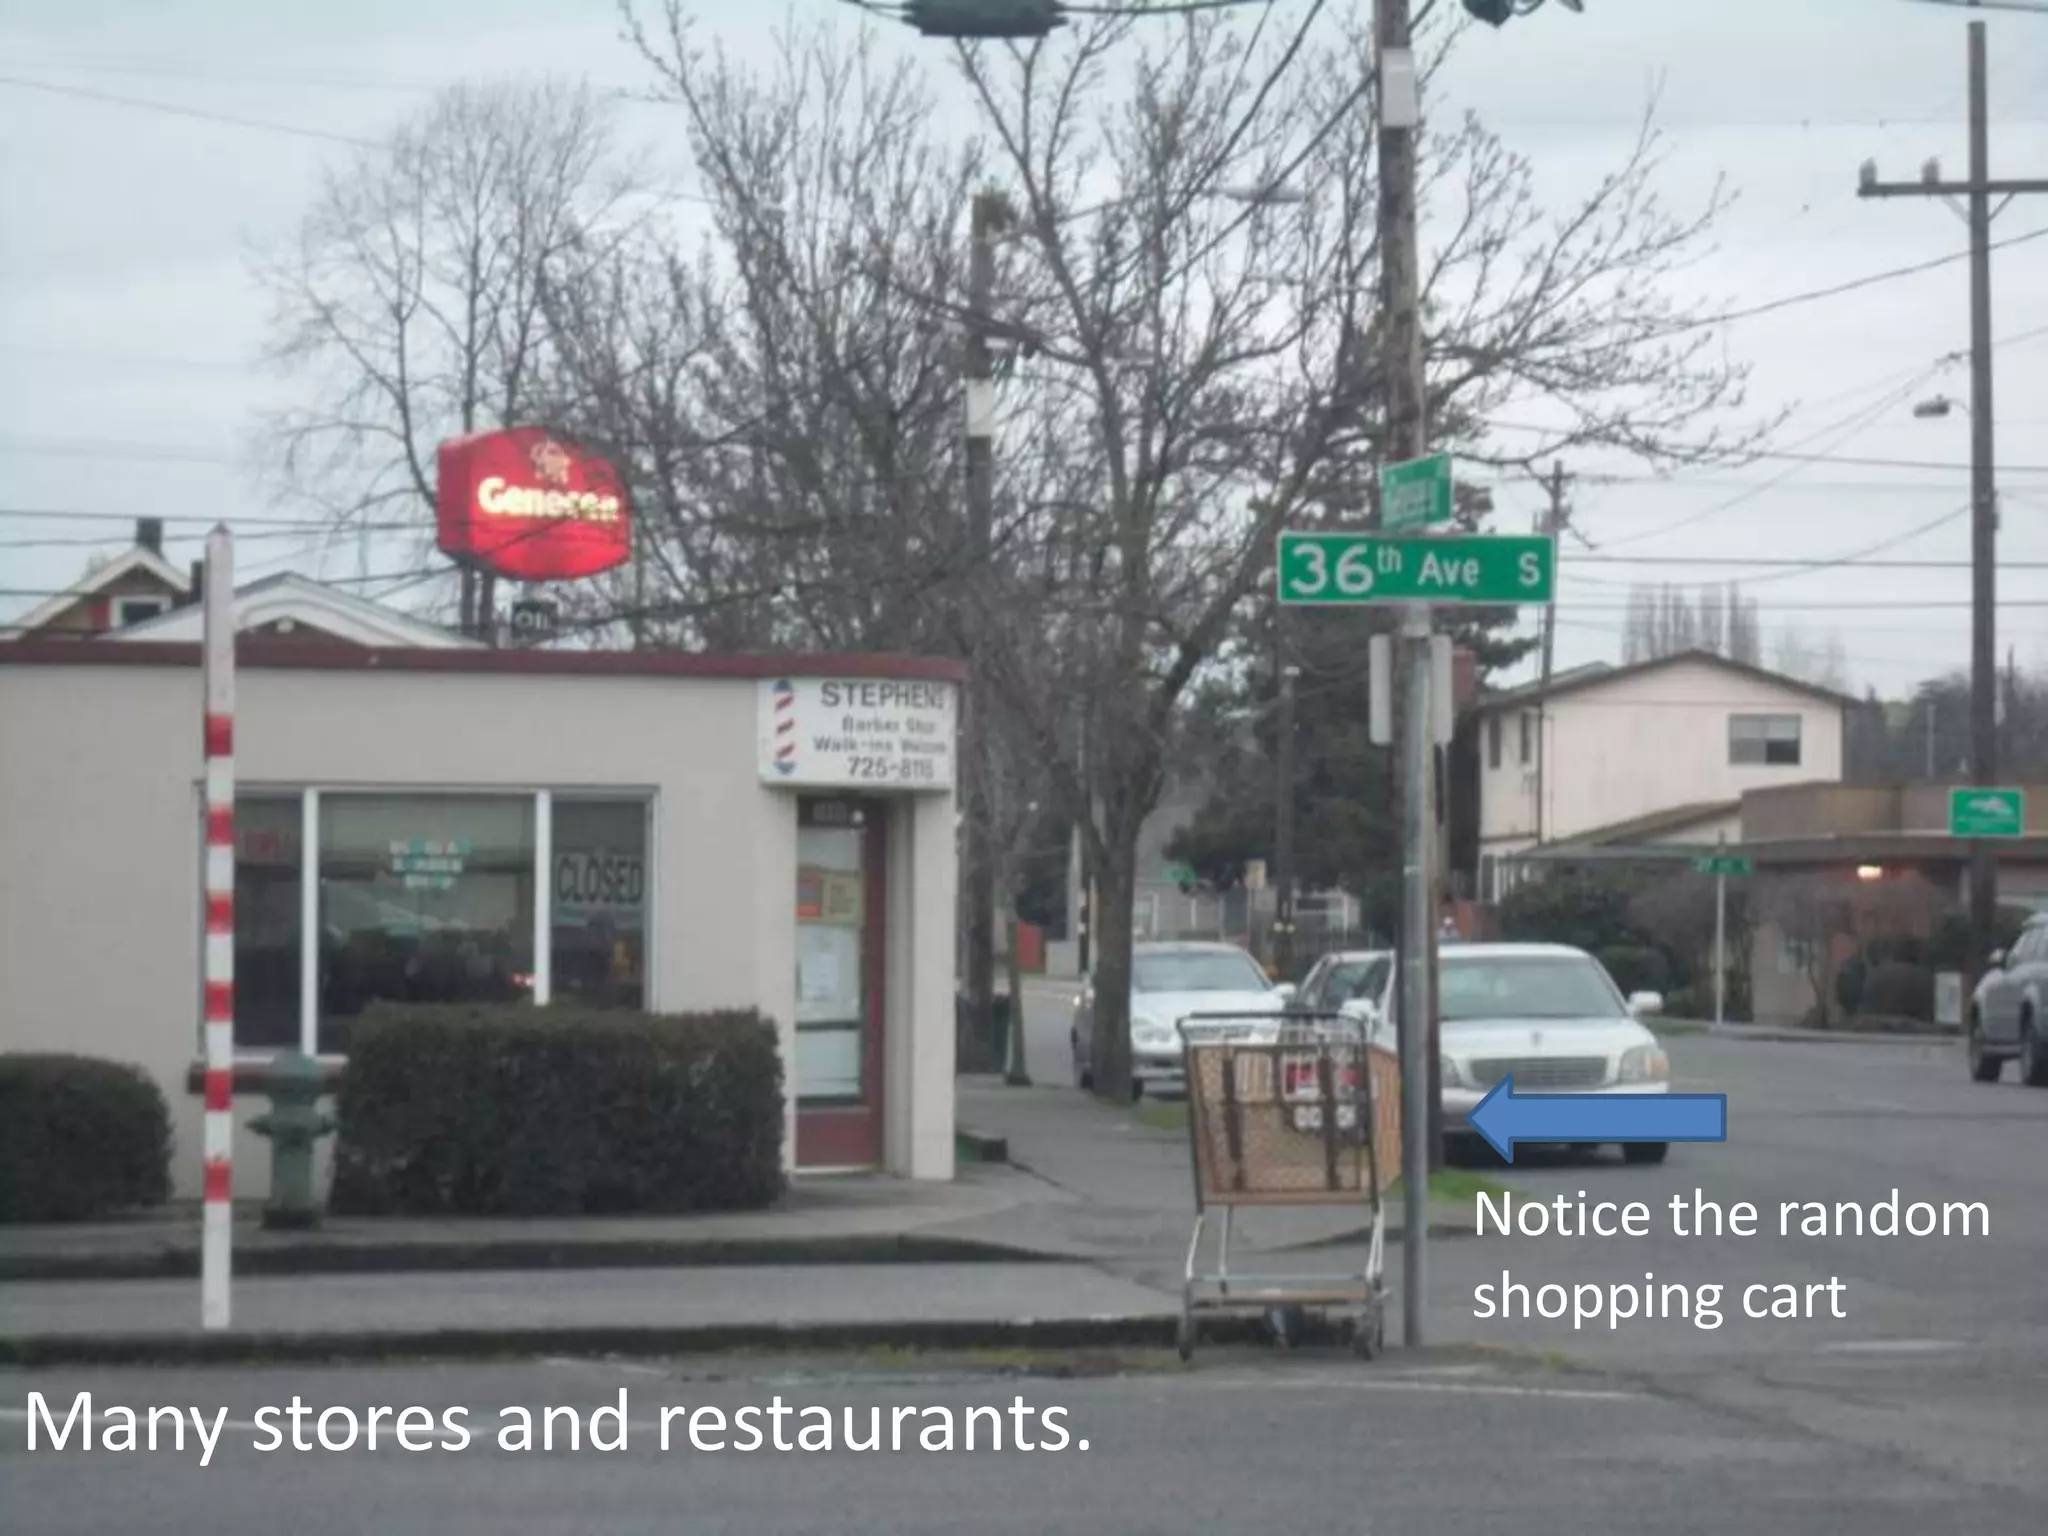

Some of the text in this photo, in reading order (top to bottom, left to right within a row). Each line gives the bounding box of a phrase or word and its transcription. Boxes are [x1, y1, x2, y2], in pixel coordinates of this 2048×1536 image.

[1289, 542, 1541, 594] 36th Ave S
[557, 856, 643, 906] CLOSED
